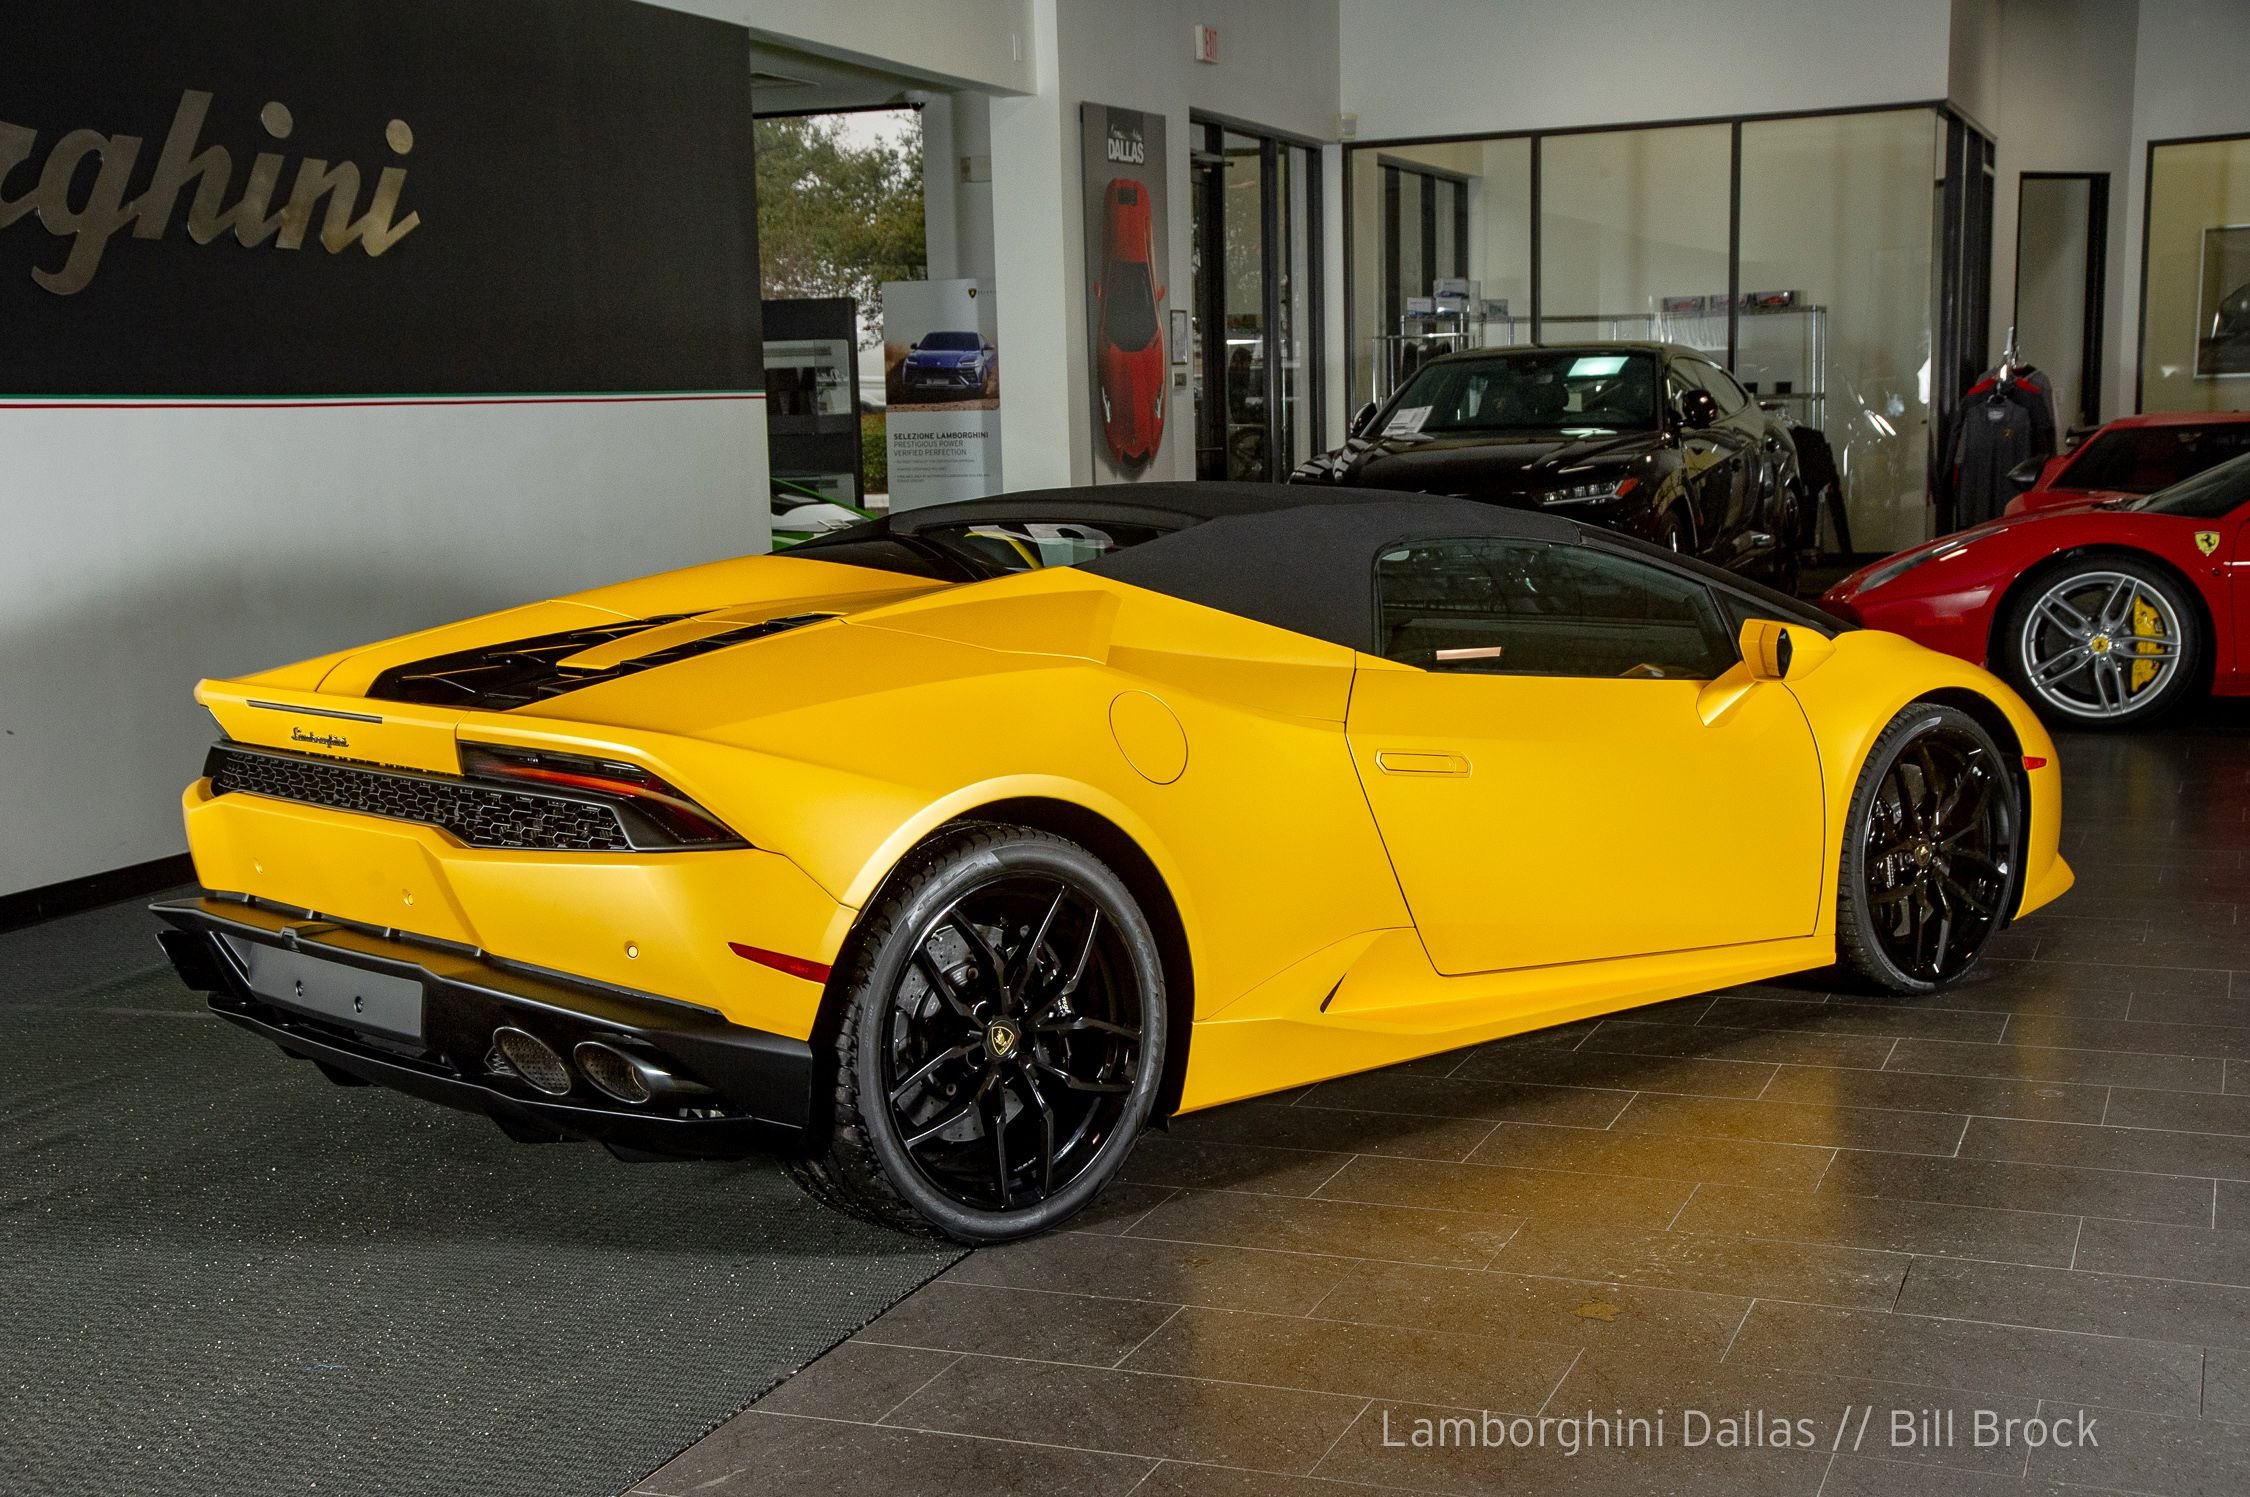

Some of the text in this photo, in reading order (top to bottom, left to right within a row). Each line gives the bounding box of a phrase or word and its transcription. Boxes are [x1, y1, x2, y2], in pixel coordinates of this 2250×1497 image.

[1108, 138, 1144, 164] DALLAS
[893, 431, 989, 440] SELEZIONE LAMBORGHINI
[893, 448, 967, 457] VERIFIED PERFECTION
